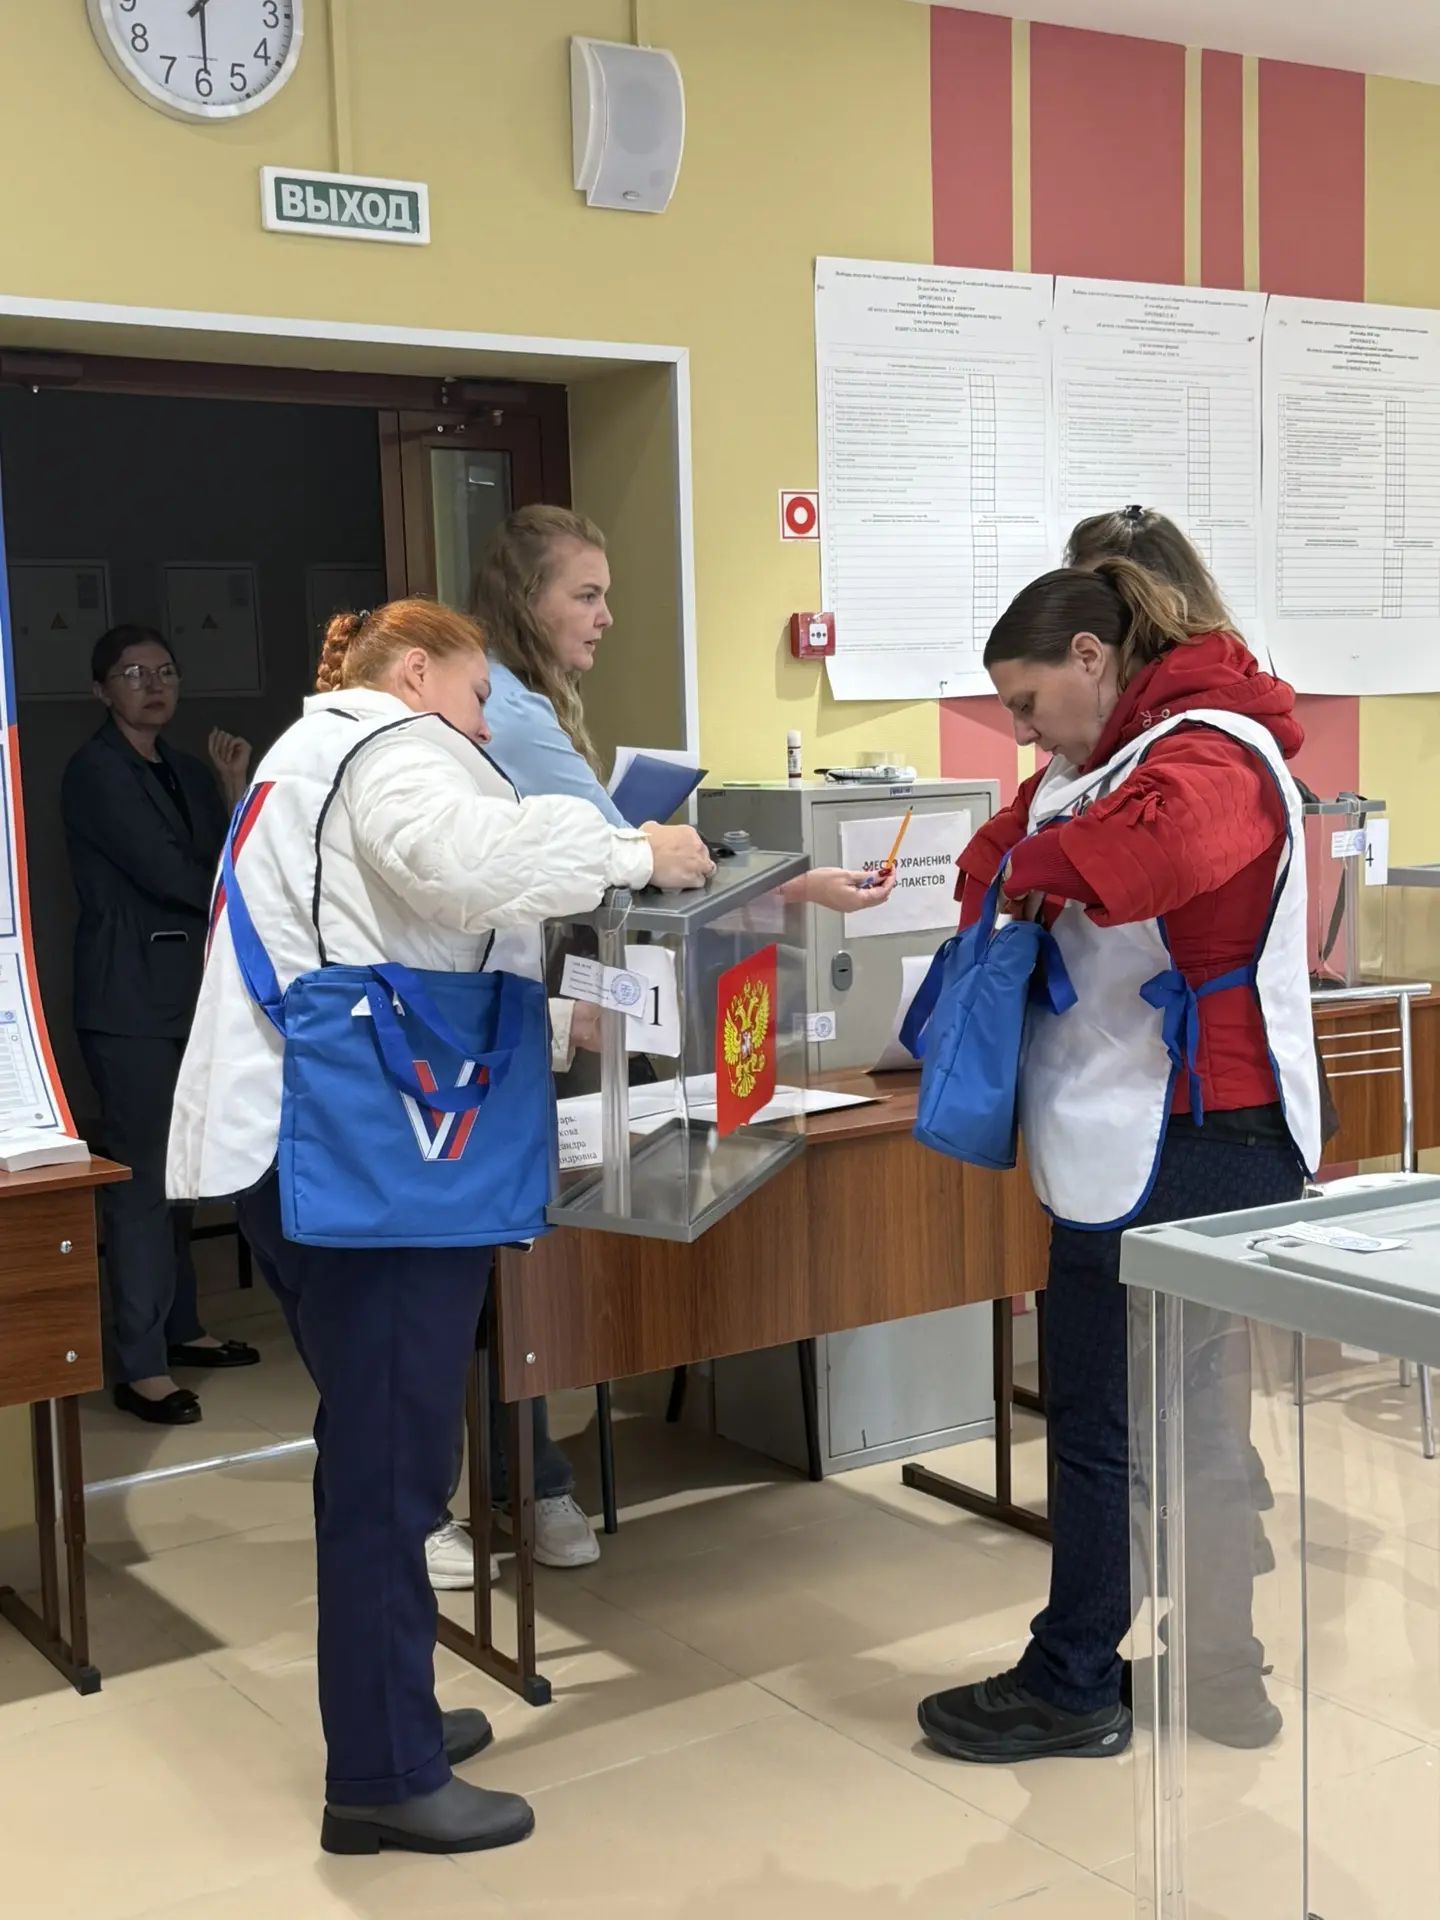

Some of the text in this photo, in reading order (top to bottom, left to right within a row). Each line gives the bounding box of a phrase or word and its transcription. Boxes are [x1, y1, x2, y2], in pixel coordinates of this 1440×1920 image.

[262, 0, 279, 29] 3
[131, 23, 149, 53] 8
[253, 38, 271, 66] 4
[159, 55, 177, 84] 7
[195, 68, 213, 97] 6
[230, 63, 247, 92] 5
[281, 183, 413, 230] ВЫХОД
[900, 854, 952, 869] ХРАНЕНИЯ
[650, 985, 664, 1027] 1
